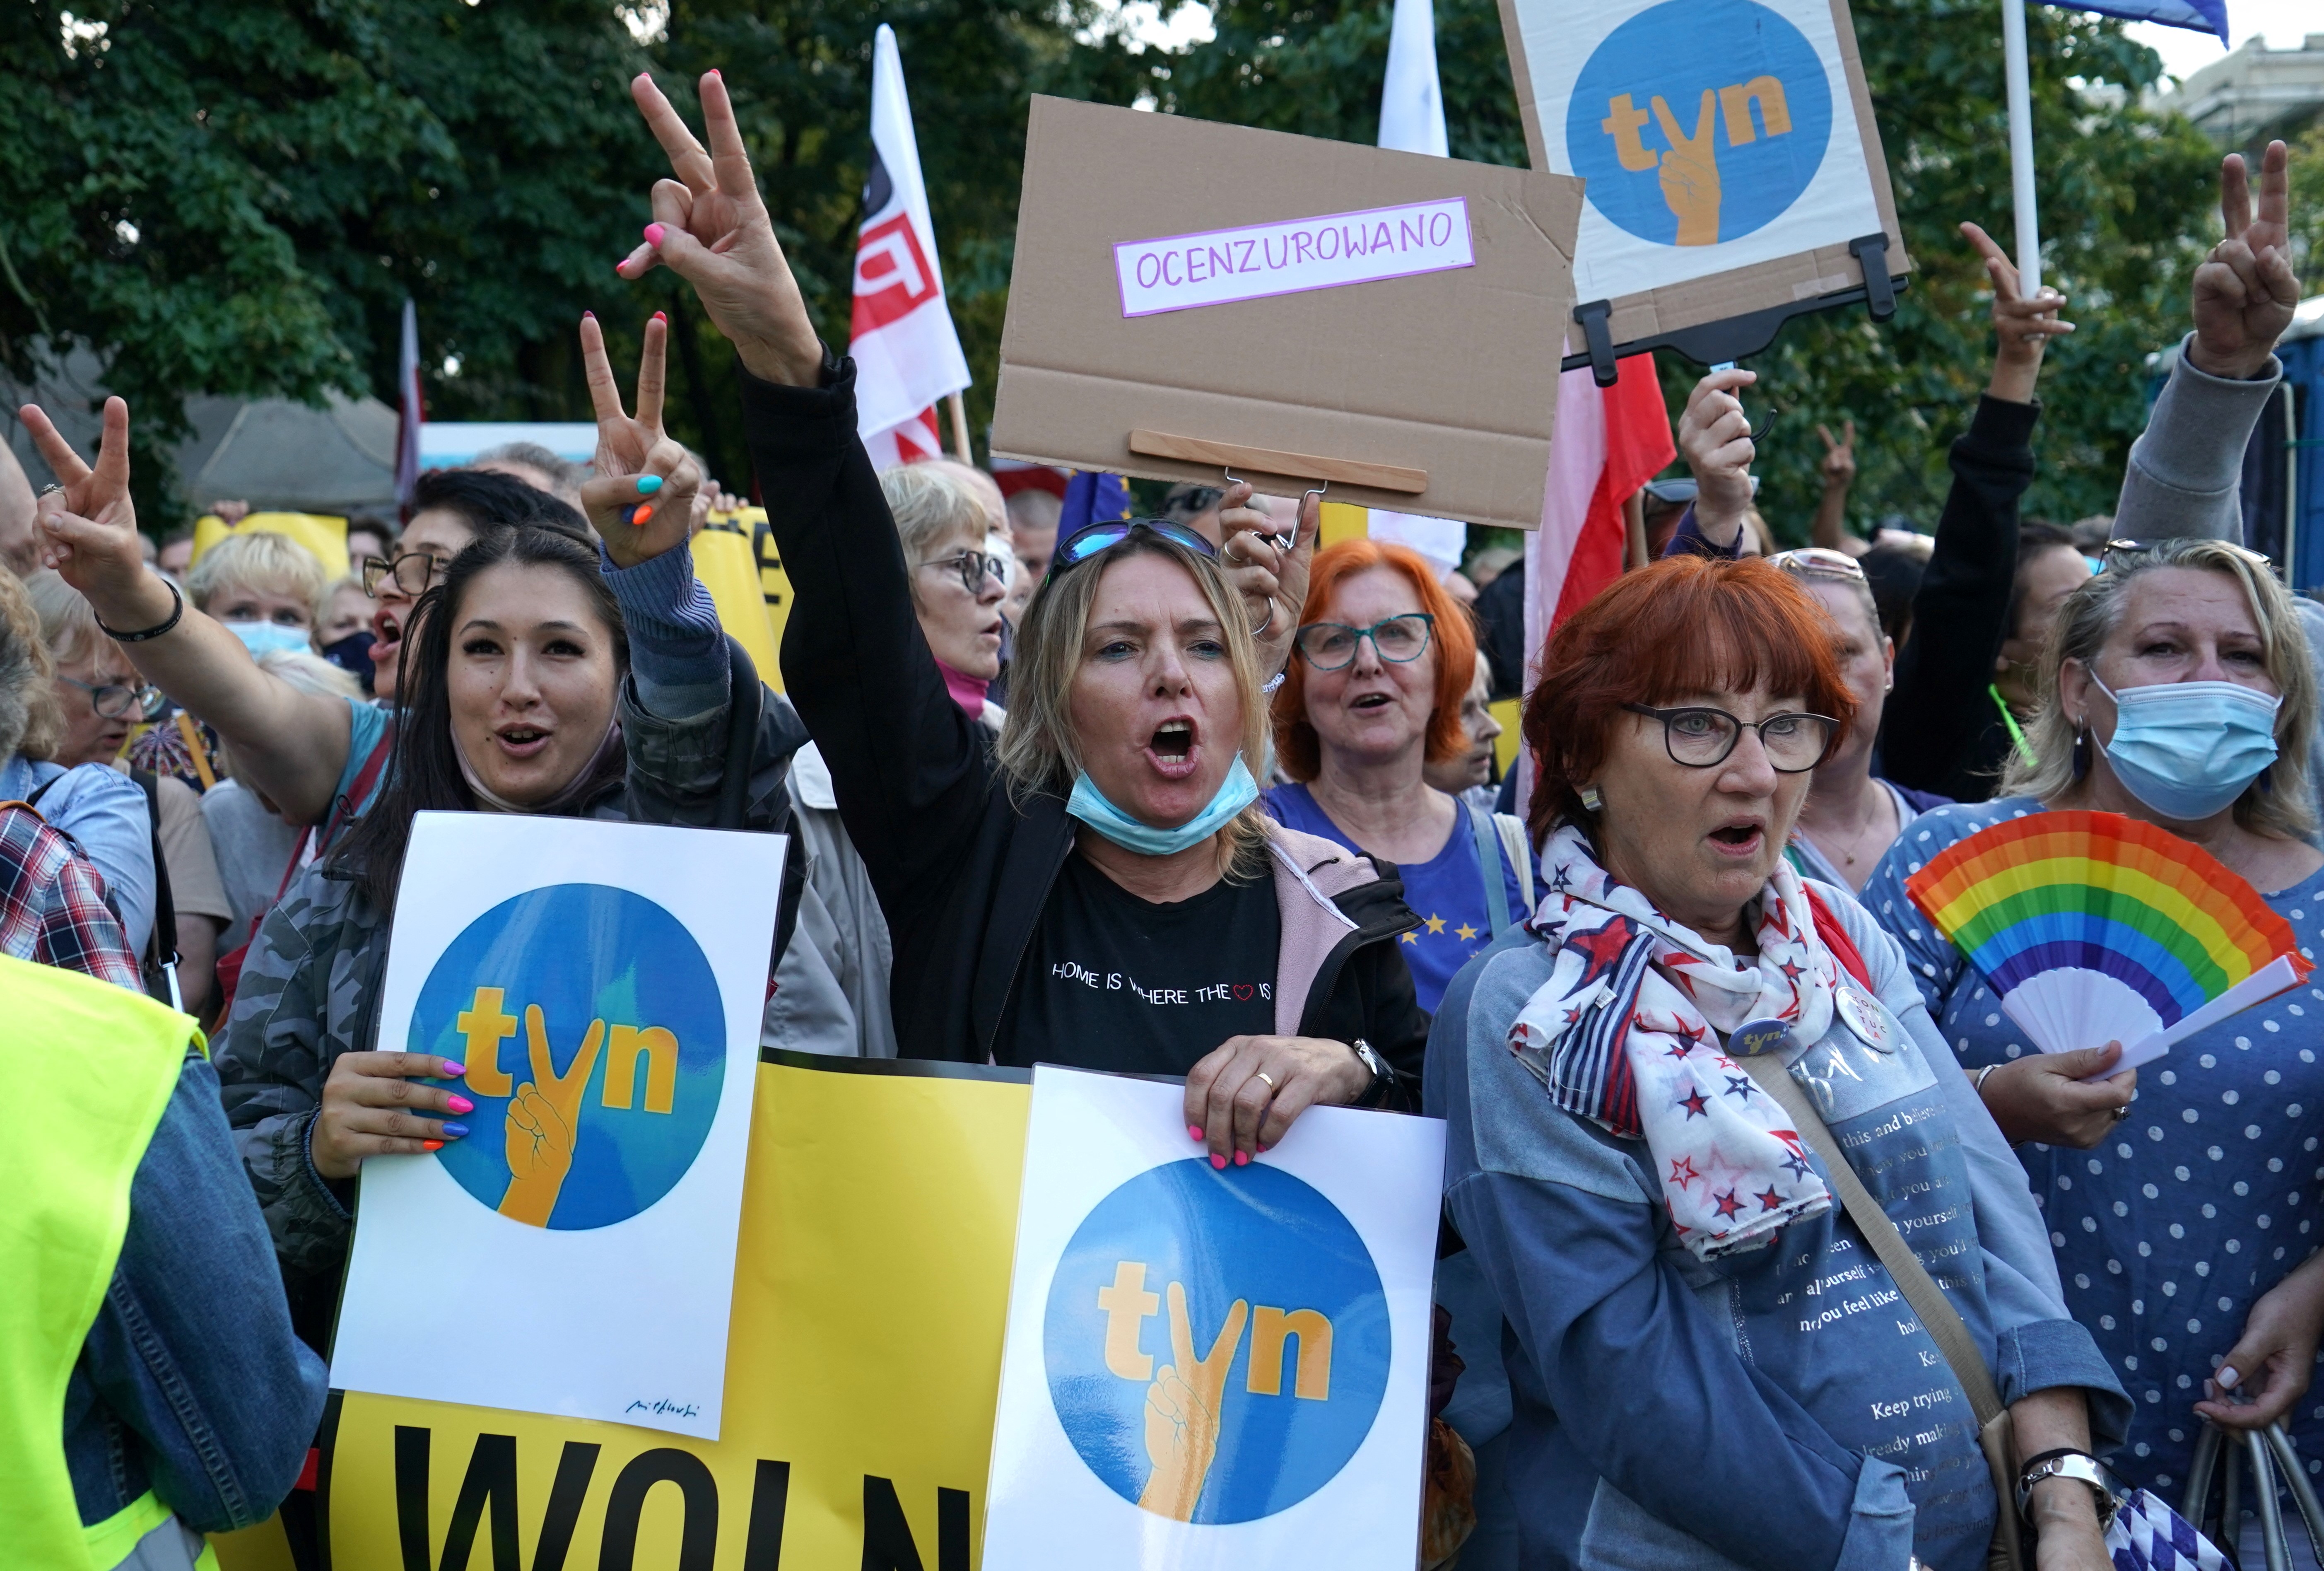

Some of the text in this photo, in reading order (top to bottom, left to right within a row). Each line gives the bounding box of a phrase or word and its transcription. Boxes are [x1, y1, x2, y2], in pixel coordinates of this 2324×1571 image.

[1602, 75, 1793, 217] tvn
[1136, 212, 1453, 289] OCENZUROWANO
[1052, 961, 1271, 1005] HOME IS WHERE THE IS
[1851, 995, 1879, 1013] KON
[1856, 1006, 1881, 1022] STY
[1859, 1016, 1887, 1033] TUC
[1743, 1031, 1781, 1054] tvn
[456, 986, 680, 1179] tvn
[1842, 1131, 1872, 1148] this
[1875, 1114, 1902, 1137] and
[1900, 1108, 1936, 1125] believe
[1898, 1146, 1928, 1168] you
[1901, 1180, 1931, 1201] you
[1929, 1238, 1967, 1264] you'd
[1843, 1296, 1871, 1315] feel
[1869, 1289, 1899, 1307] like
[1938, 1274, 1968, 1290] this
[1097, 1260, 1334, 1471] tvn
[1871, 1400, 1910, 1420] Keep
[1913, 1388, 1952, 1409] trying
[1862, 1436, 1910, 1456] lready
